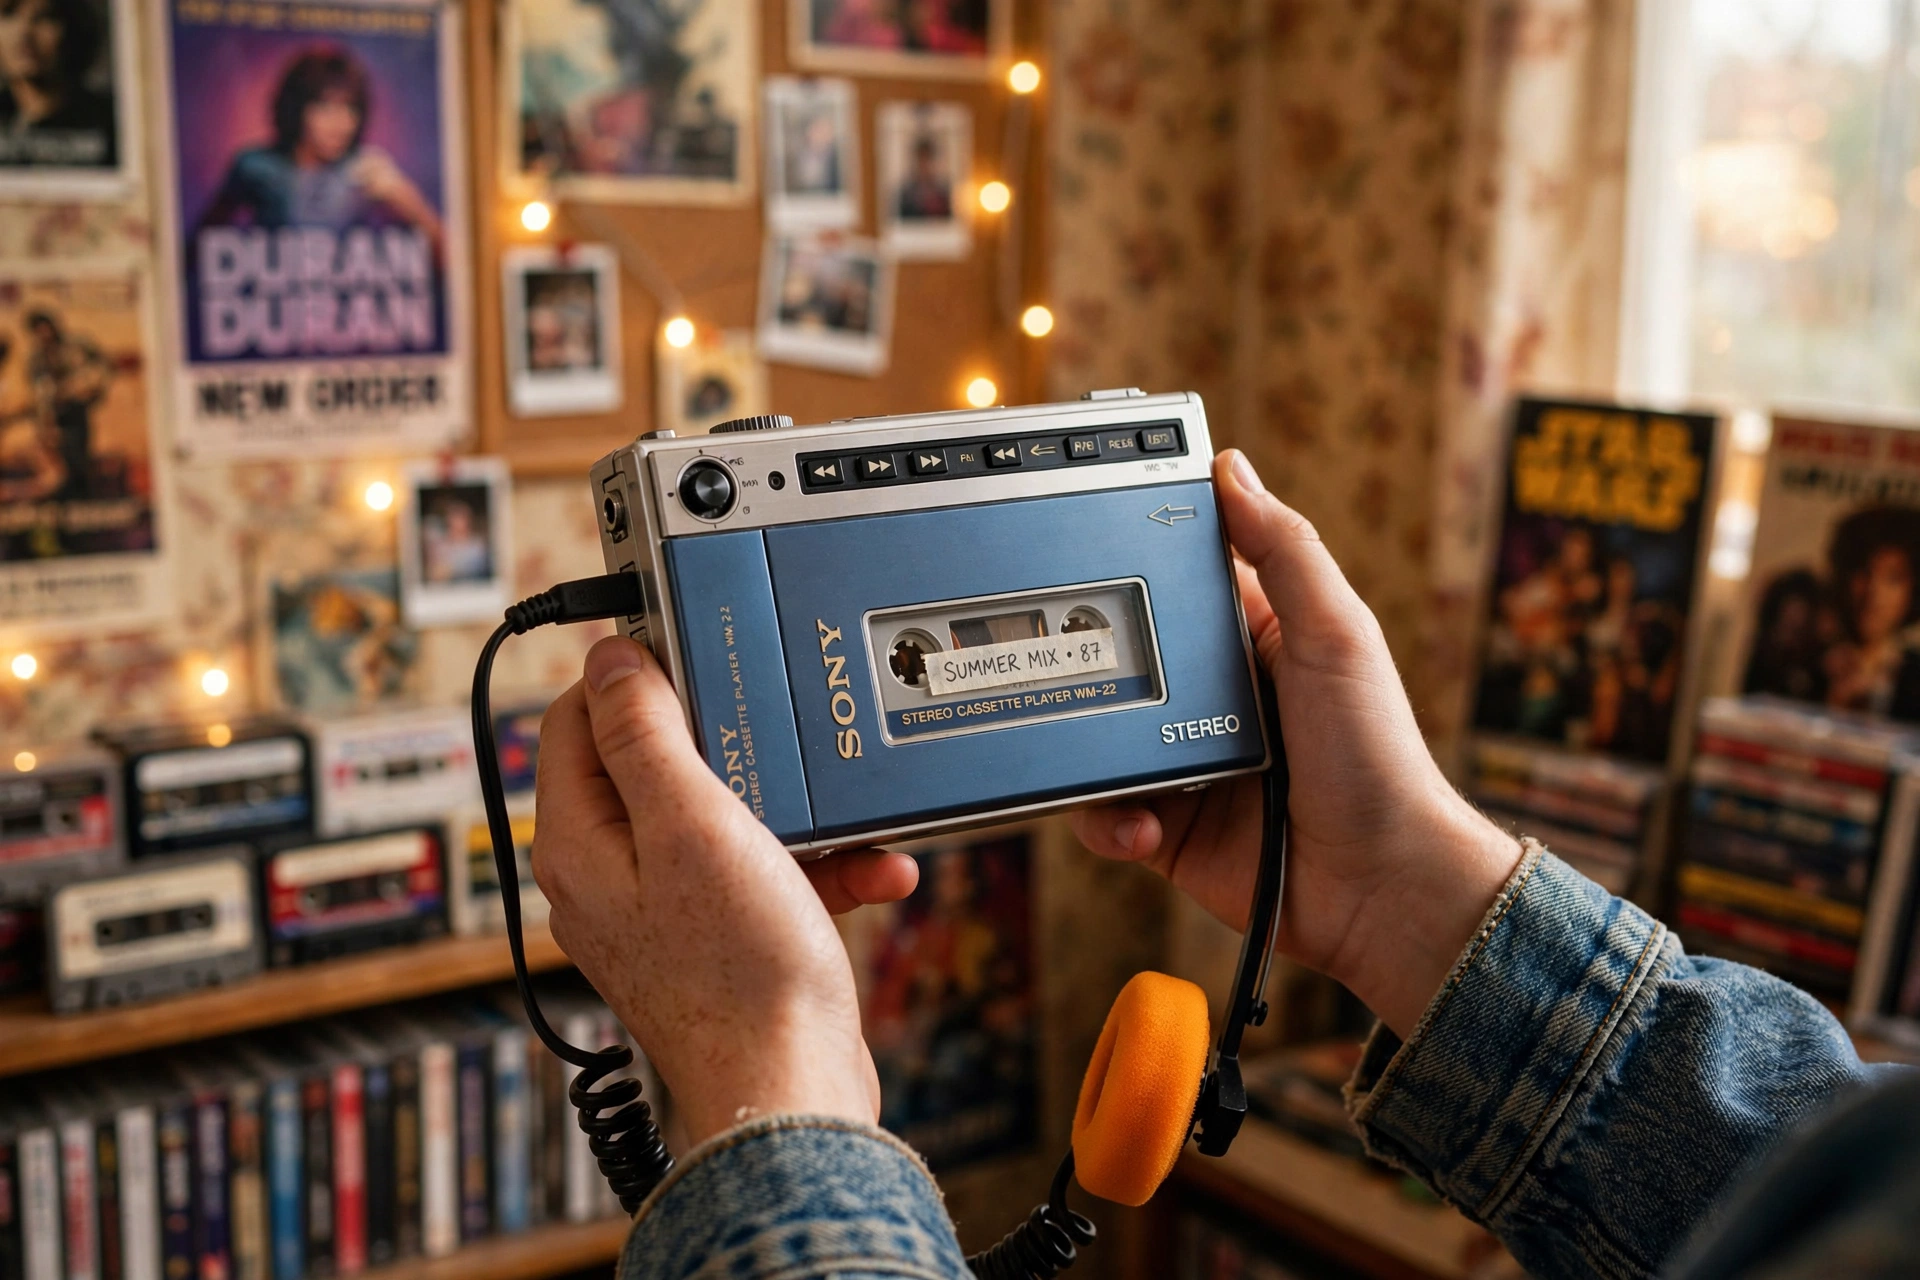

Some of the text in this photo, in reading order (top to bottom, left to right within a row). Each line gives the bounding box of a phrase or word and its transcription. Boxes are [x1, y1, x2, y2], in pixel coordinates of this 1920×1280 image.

[200, 227, 432, 289] DURAN
[203, 291, 435, 354] DURAN
[728, 651, 745, 699] PLAYER
[816, 618, 863, 760] SONY
[943, 653, 1021, 682] SUMMER
[1028, 648, 1060, 669] MIX
[1081, 642, 1101, 662] 87
[902, 683, 1117, 725] STEREO CASSETTE PLAYER WM-22
[1161, 714, 1240, 744] STEREO
[736, 703, 756, 766] CASSETTE
[720, 724, 748, 807] ONY
[748, 771, 765, 819] STEREO
